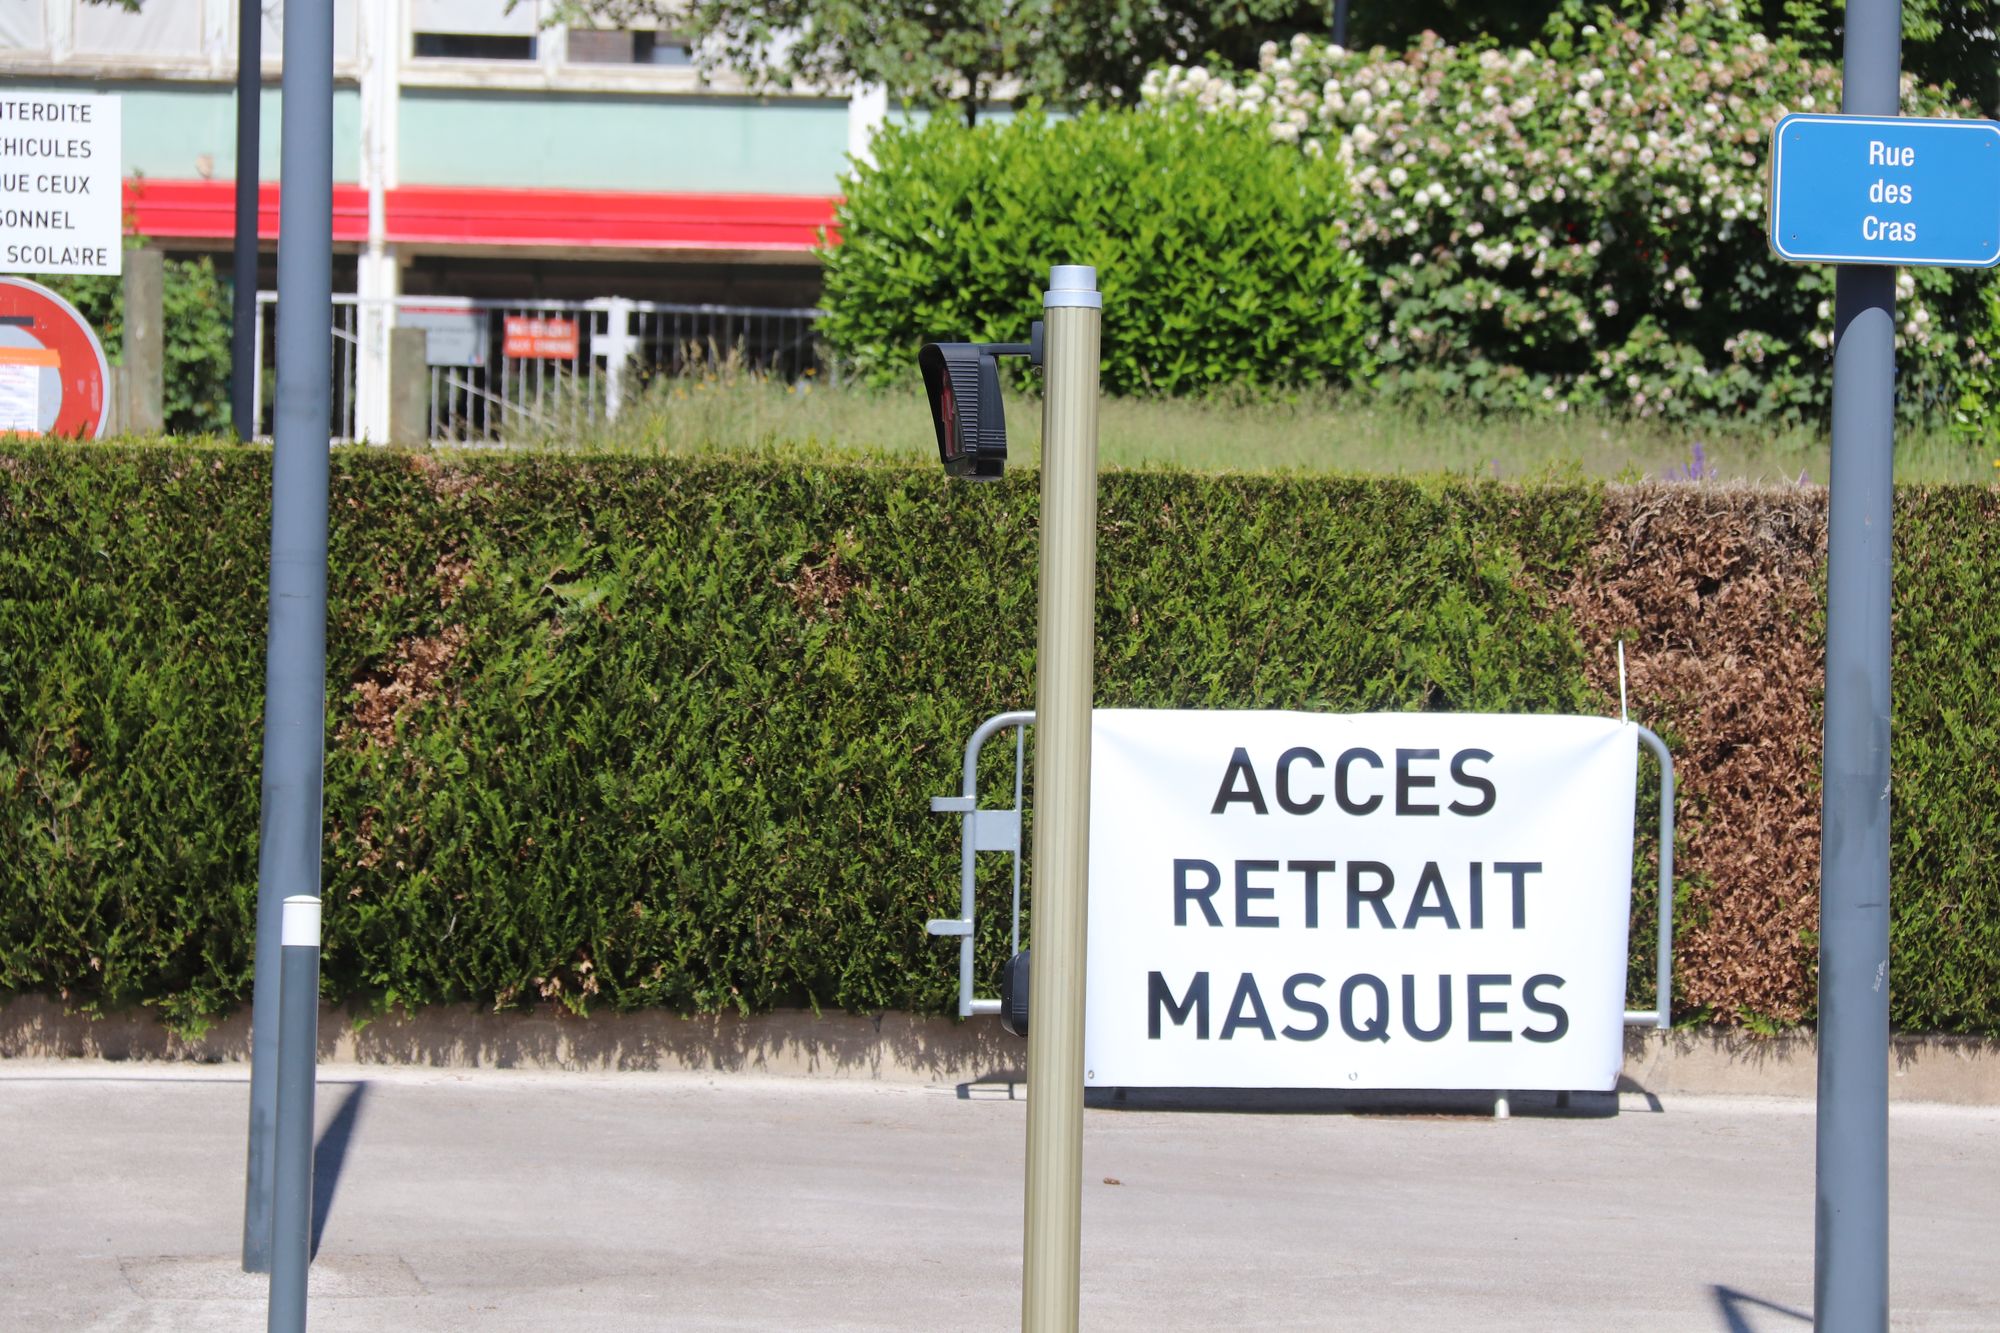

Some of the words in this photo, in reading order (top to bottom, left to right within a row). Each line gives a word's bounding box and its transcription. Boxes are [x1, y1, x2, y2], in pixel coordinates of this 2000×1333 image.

[0, 102, 92, 123] TERDITE
[0, 137, 92, 158] HICULES
[1869, 140, 1915, 167] Rue
[0, 173, 30, 193] UE
[37, 174, 90, 195] CEUX
[1869, 178, 1913, 205] des
[0, 209, 76, 230] ONNEL
[1862, 215, 1917, 242] Cras
[7, 245, 108, 267] SCOLAIRE
[1210, 746, 1498, 818] ACCES
[1172, 857, 1543, 930] RETRAIT
[1146, 970, 1570, 1044] MASQUES
